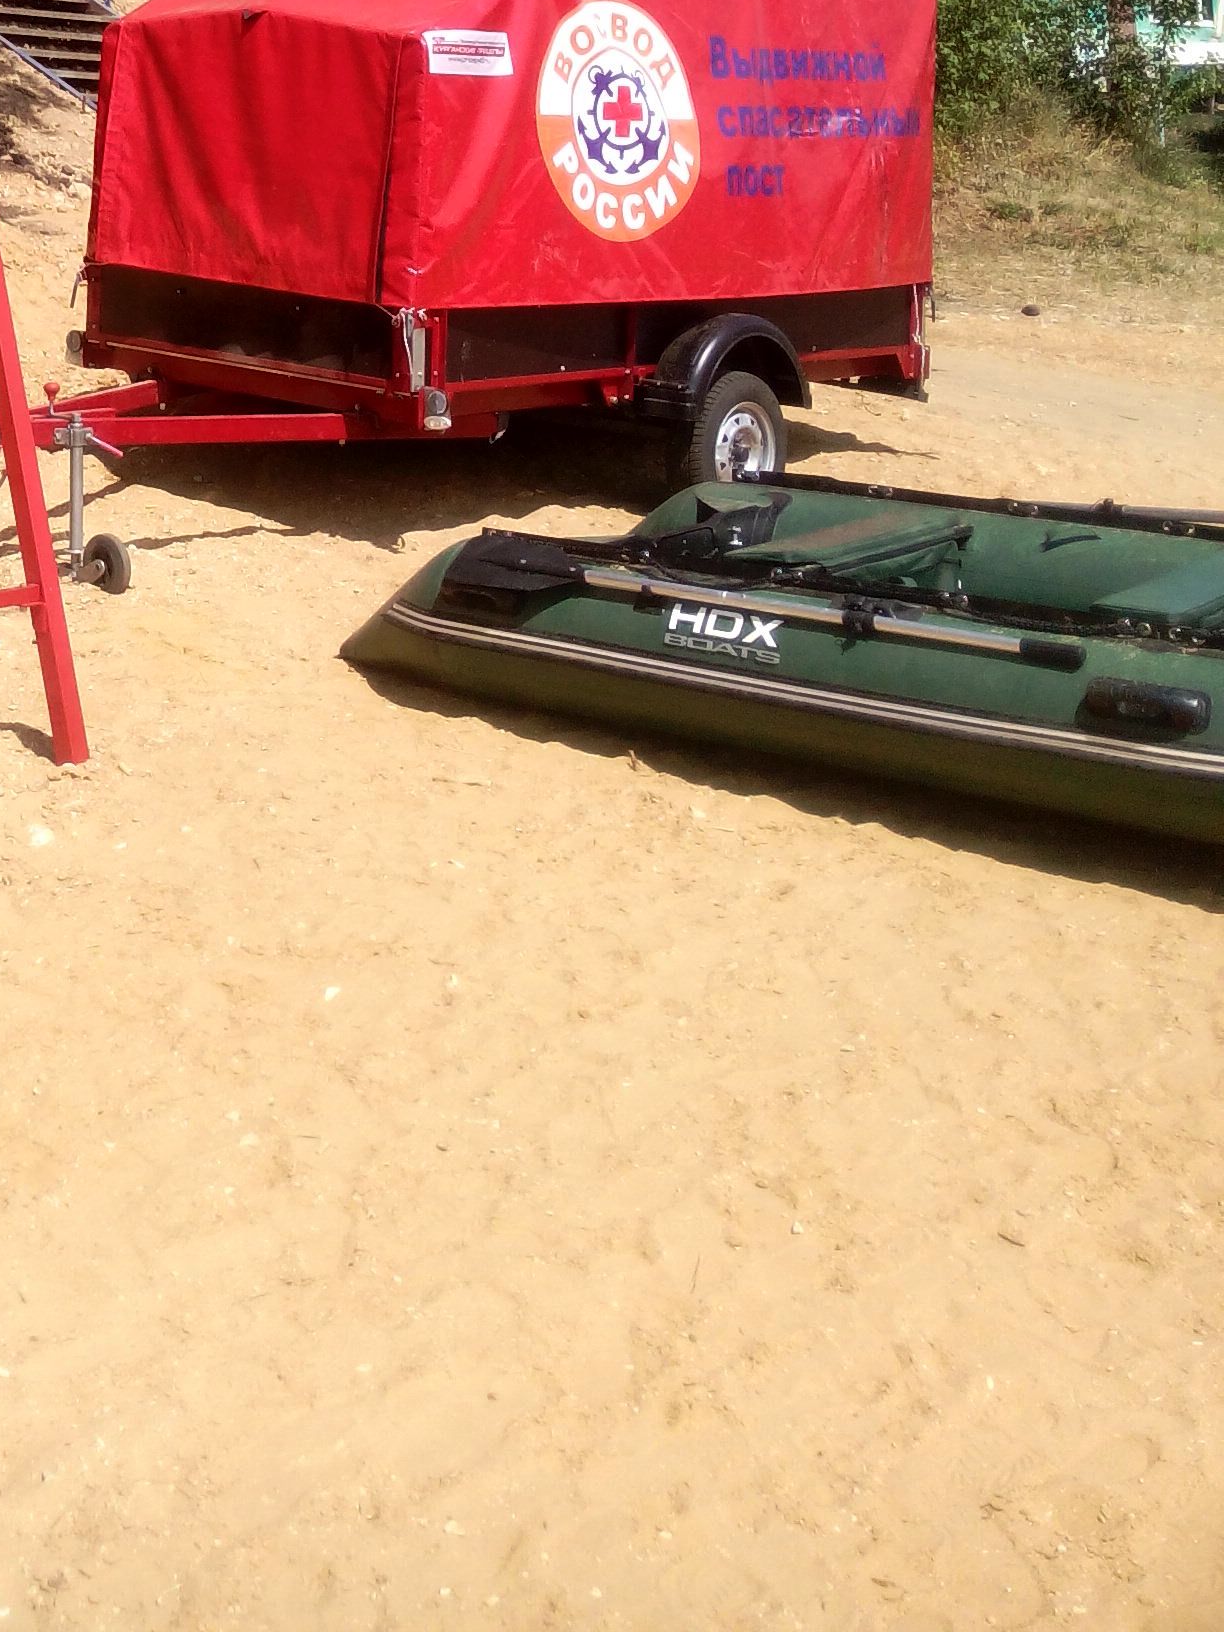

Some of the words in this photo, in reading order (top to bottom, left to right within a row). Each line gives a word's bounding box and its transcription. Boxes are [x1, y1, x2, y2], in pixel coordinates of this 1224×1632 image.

[709, 34, 887, 89] Выдвижной
[552, 140, 695, 231] РОССИИ
[727, 164, 785, 197] пост
[668, 603, 785, 648] HDX
[663, 632, 781, 665] BOATS
